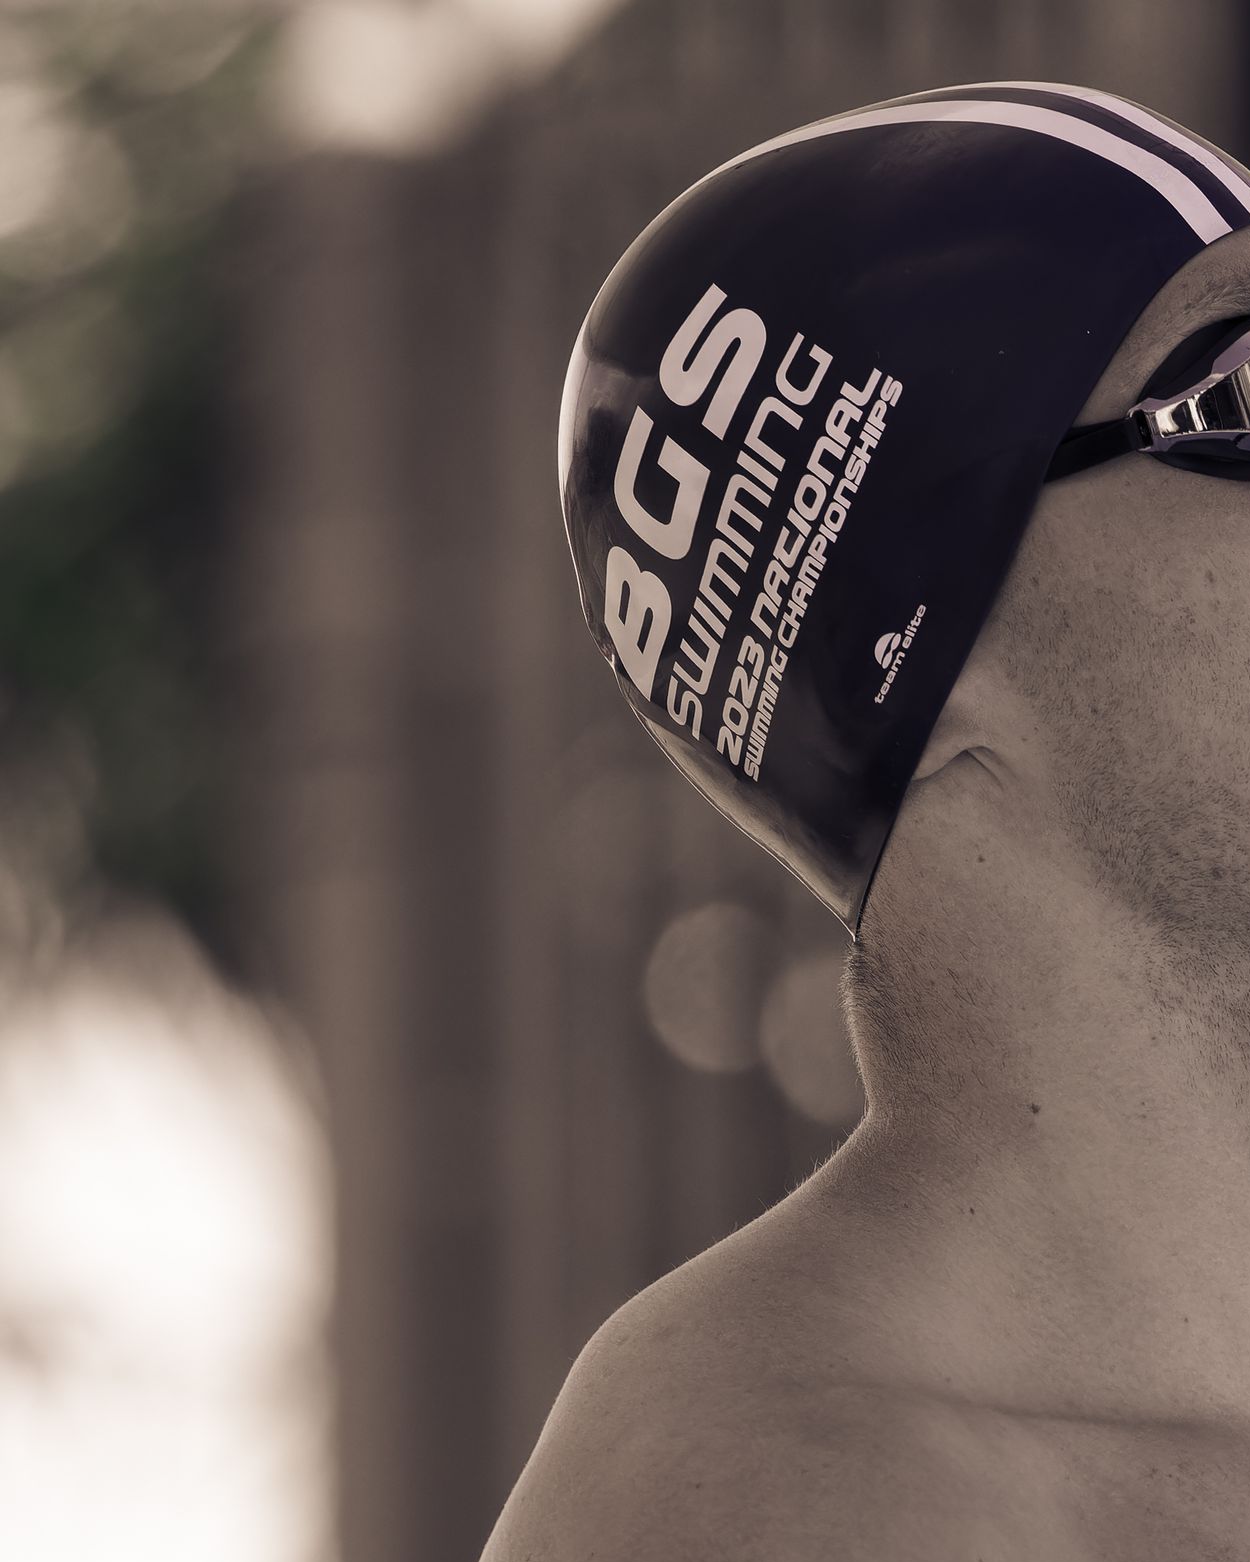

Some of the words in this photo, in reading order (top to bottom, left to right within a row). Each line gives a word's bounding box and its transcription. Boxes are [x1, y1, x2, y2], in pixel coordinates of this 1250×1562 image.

[604, 283, 767, 701] BGS
[667, 332, 834, 741] SWIMMING
[716, 635, 765, 767] 2023
[750, 367, 882, 640] NATIONAL
[743, 644, 789, 782] SWIMMING
[777, 375, 903, 648] CHAMPIONSHIPS
[874, 651, 906, 704] team
[902, 604, 927, 649] elite
